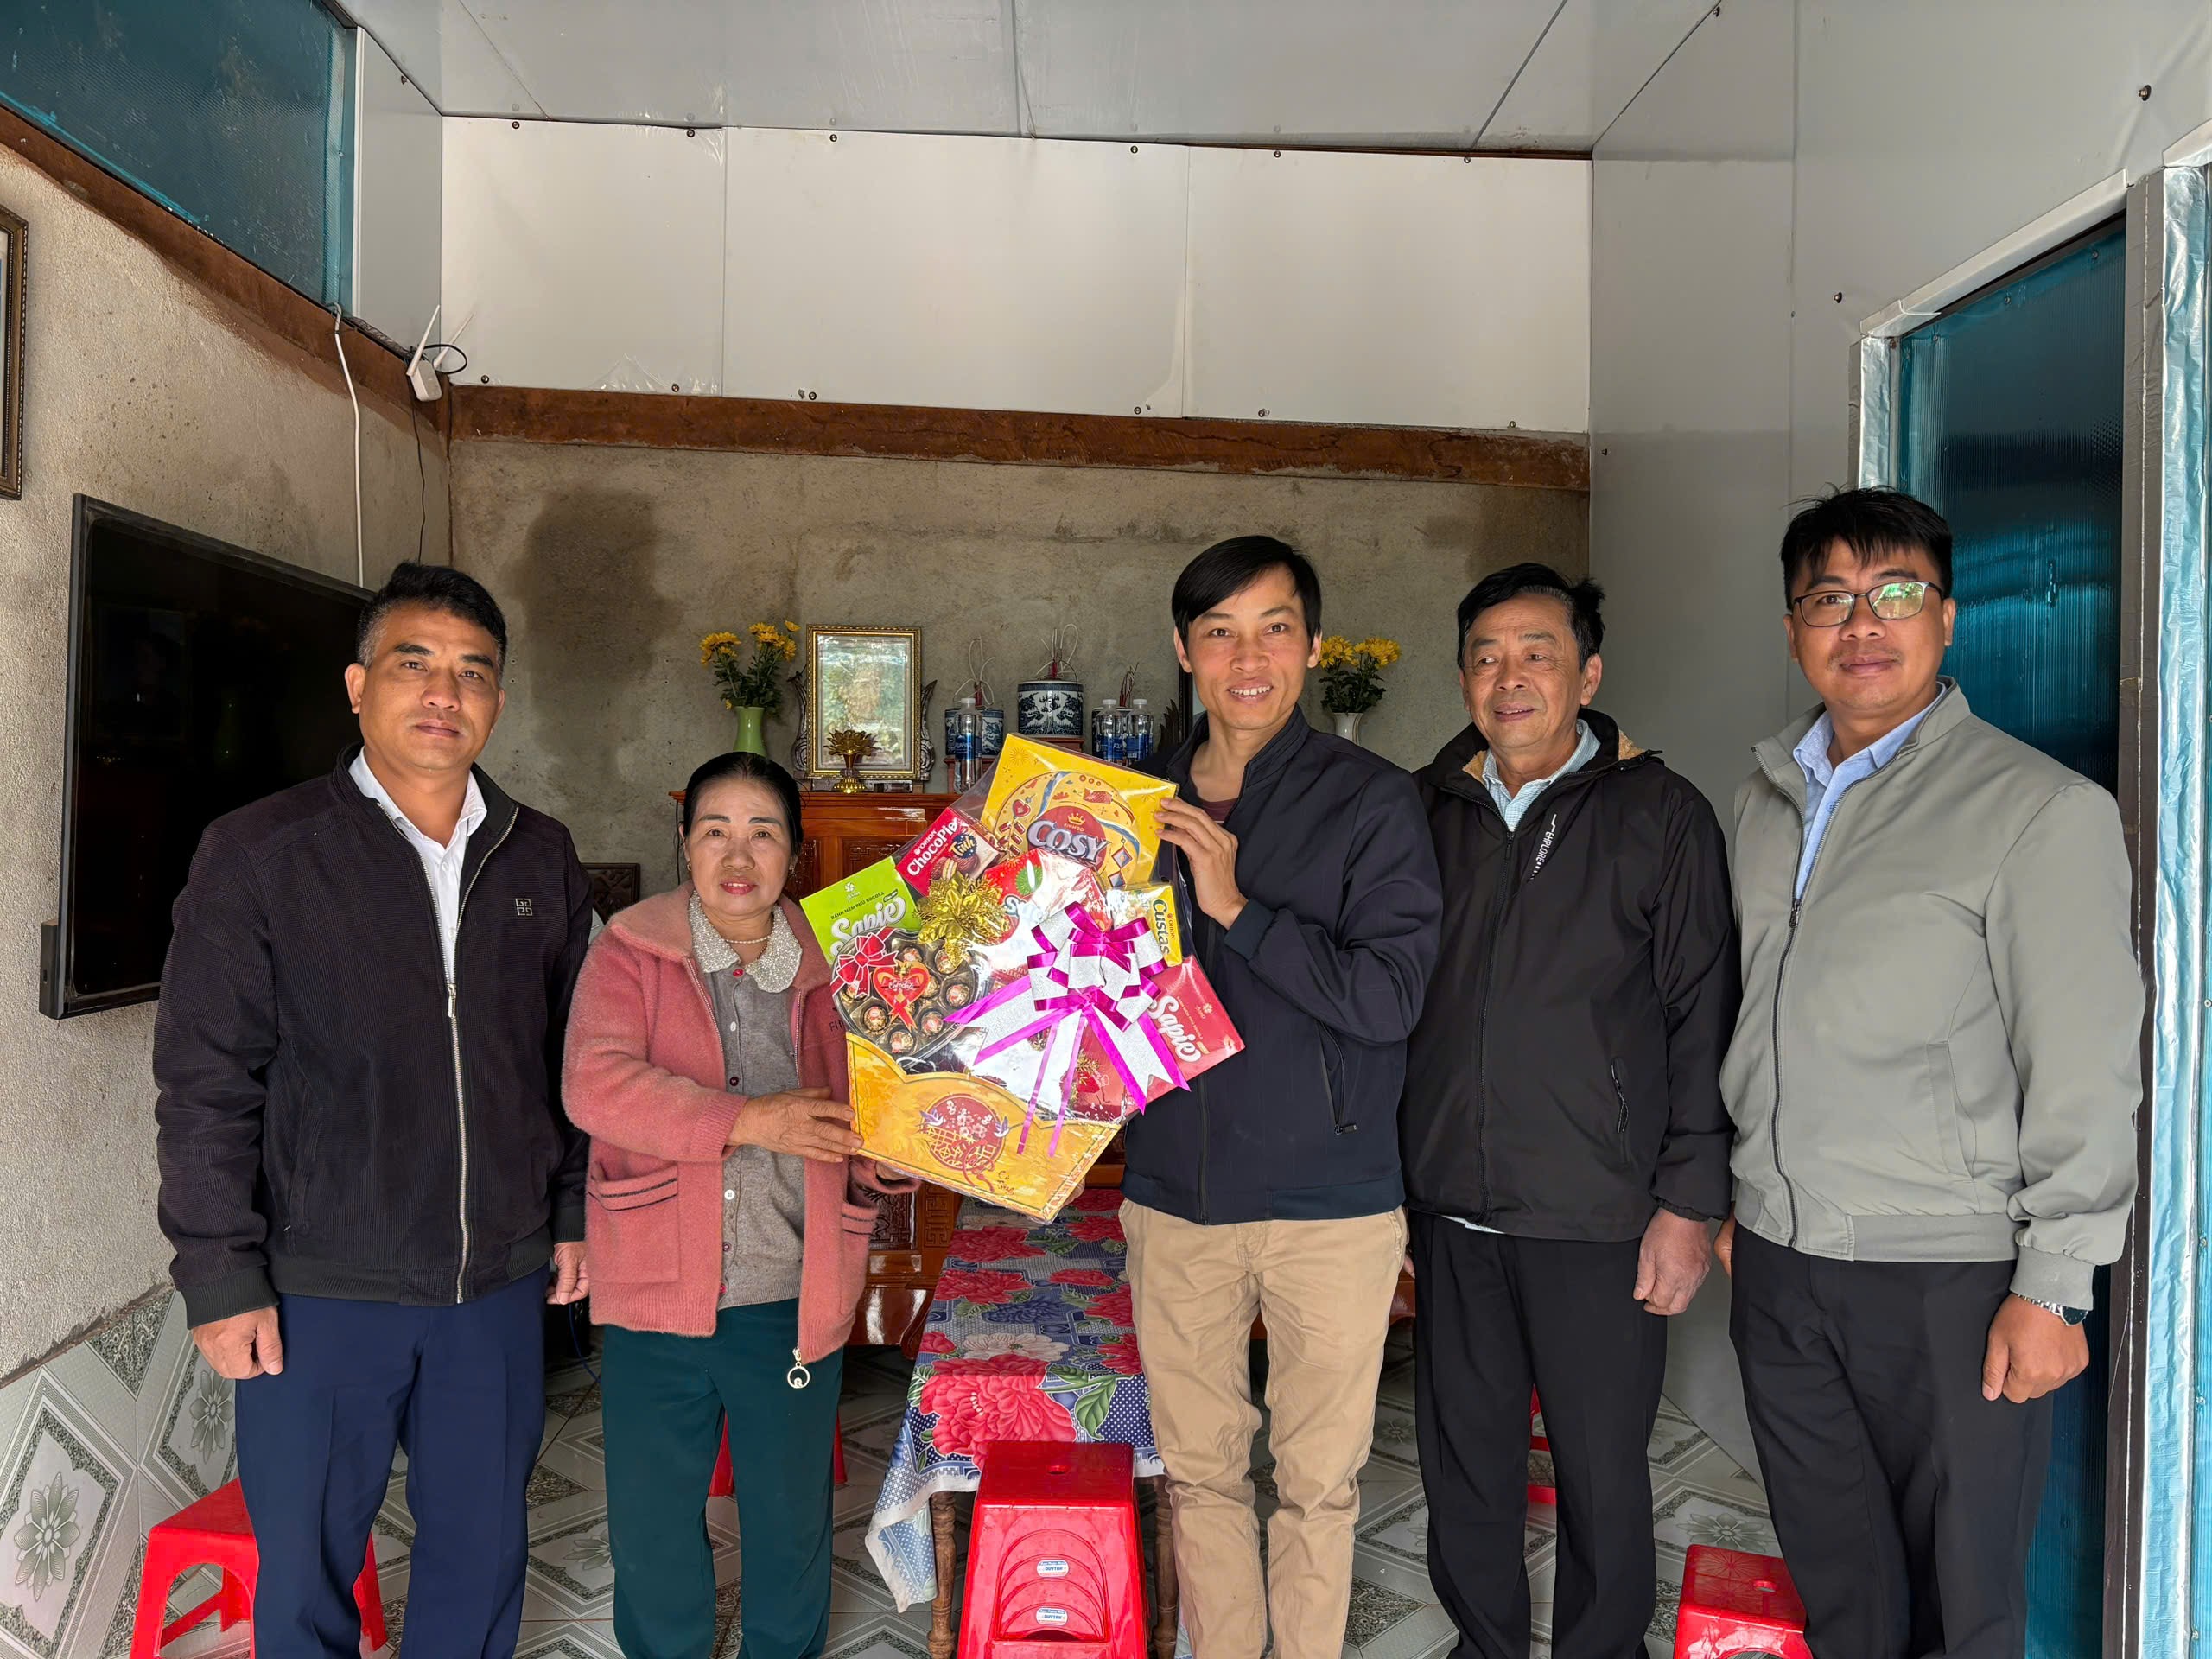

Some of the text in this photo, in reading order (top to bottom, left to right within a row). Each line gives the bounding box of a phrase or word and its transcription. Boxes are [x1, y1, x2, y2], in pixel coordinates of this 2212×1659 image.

[906, 817, 958, 876] ChocoPie
[1027, 819, 1109, 862] COSY
[1152, 899, 1170, 955] Custas
[1147, 995, 1203, 1063] Sapie
